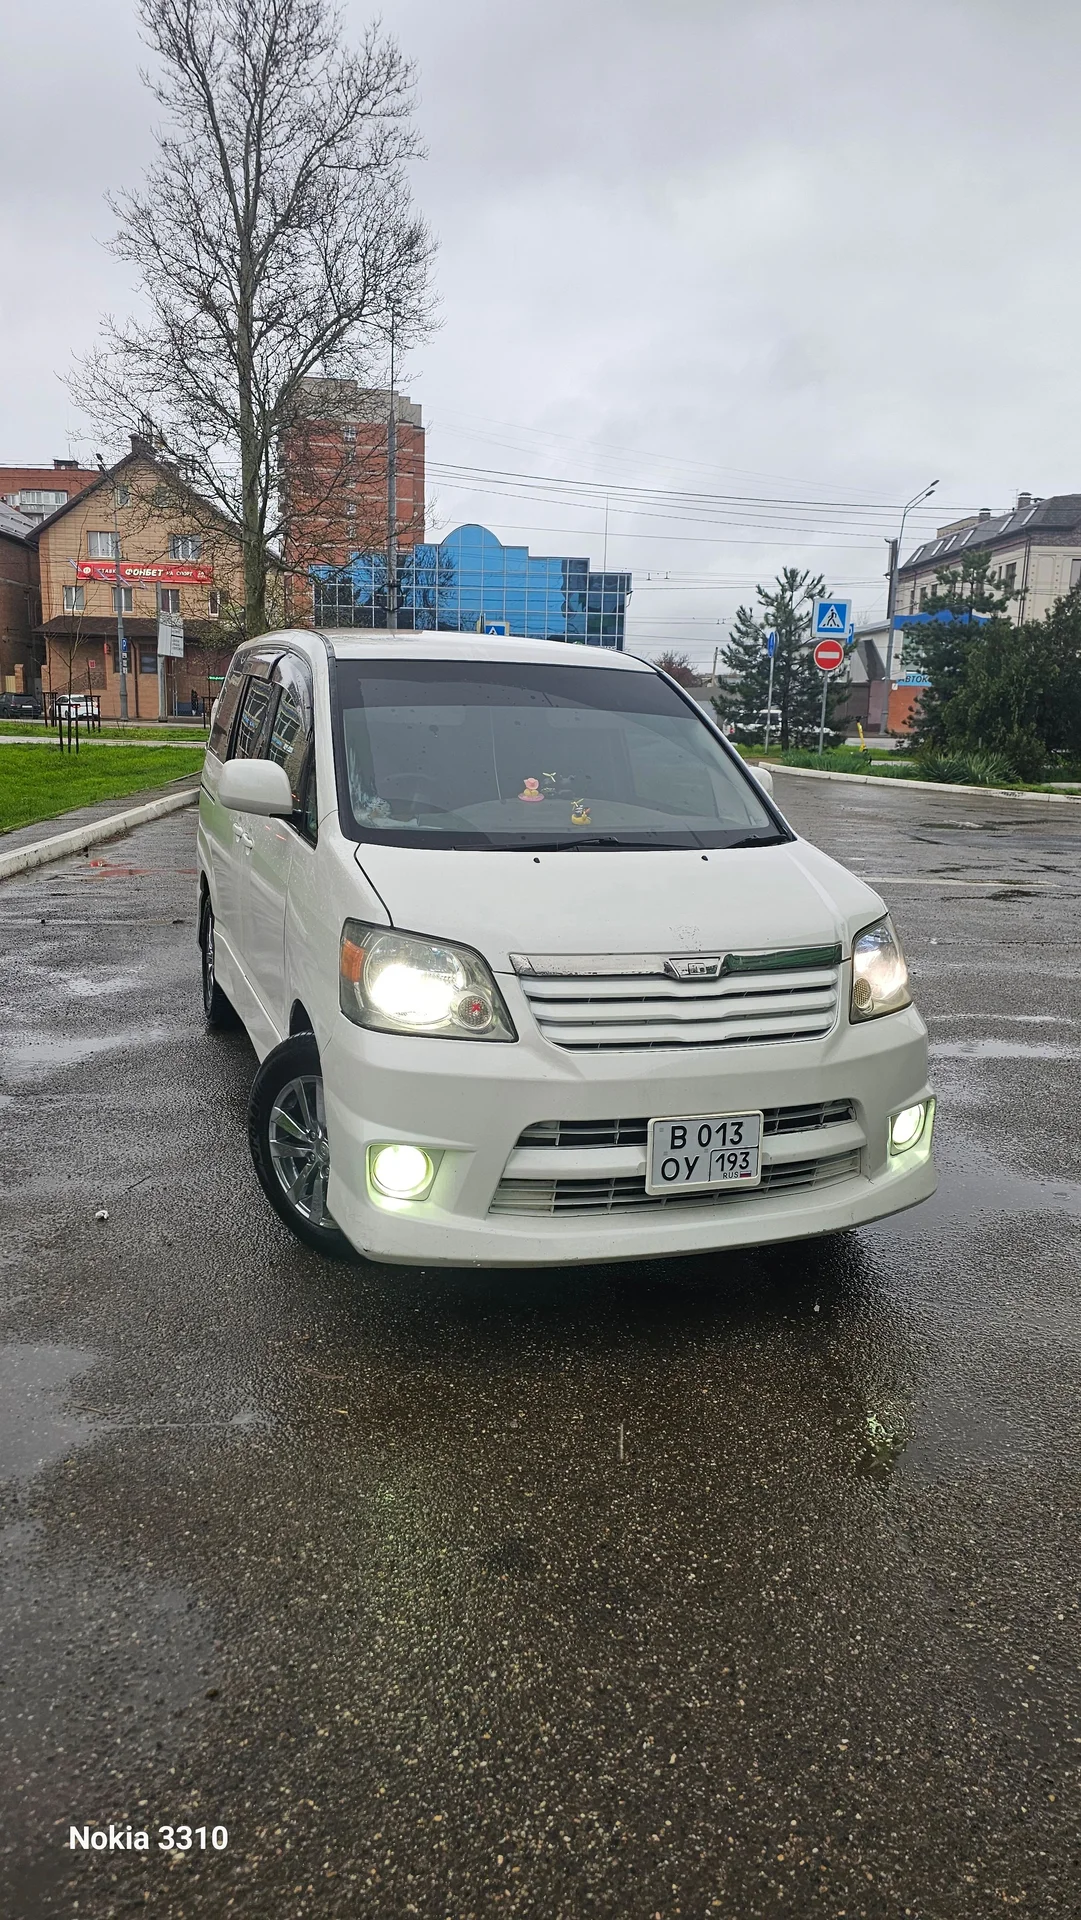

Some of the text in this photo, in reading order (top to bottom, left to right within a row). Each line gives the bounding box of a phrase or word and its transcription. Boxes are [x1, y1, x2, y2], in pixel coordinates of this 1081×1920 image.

[125, 568, 163, 577] ФОНБЕТ
[670, 1121, 744, 1150] В 013
[661, 1151, 750, 1182] ОУ 193
[722, 1171, 739, 1179] RUS
